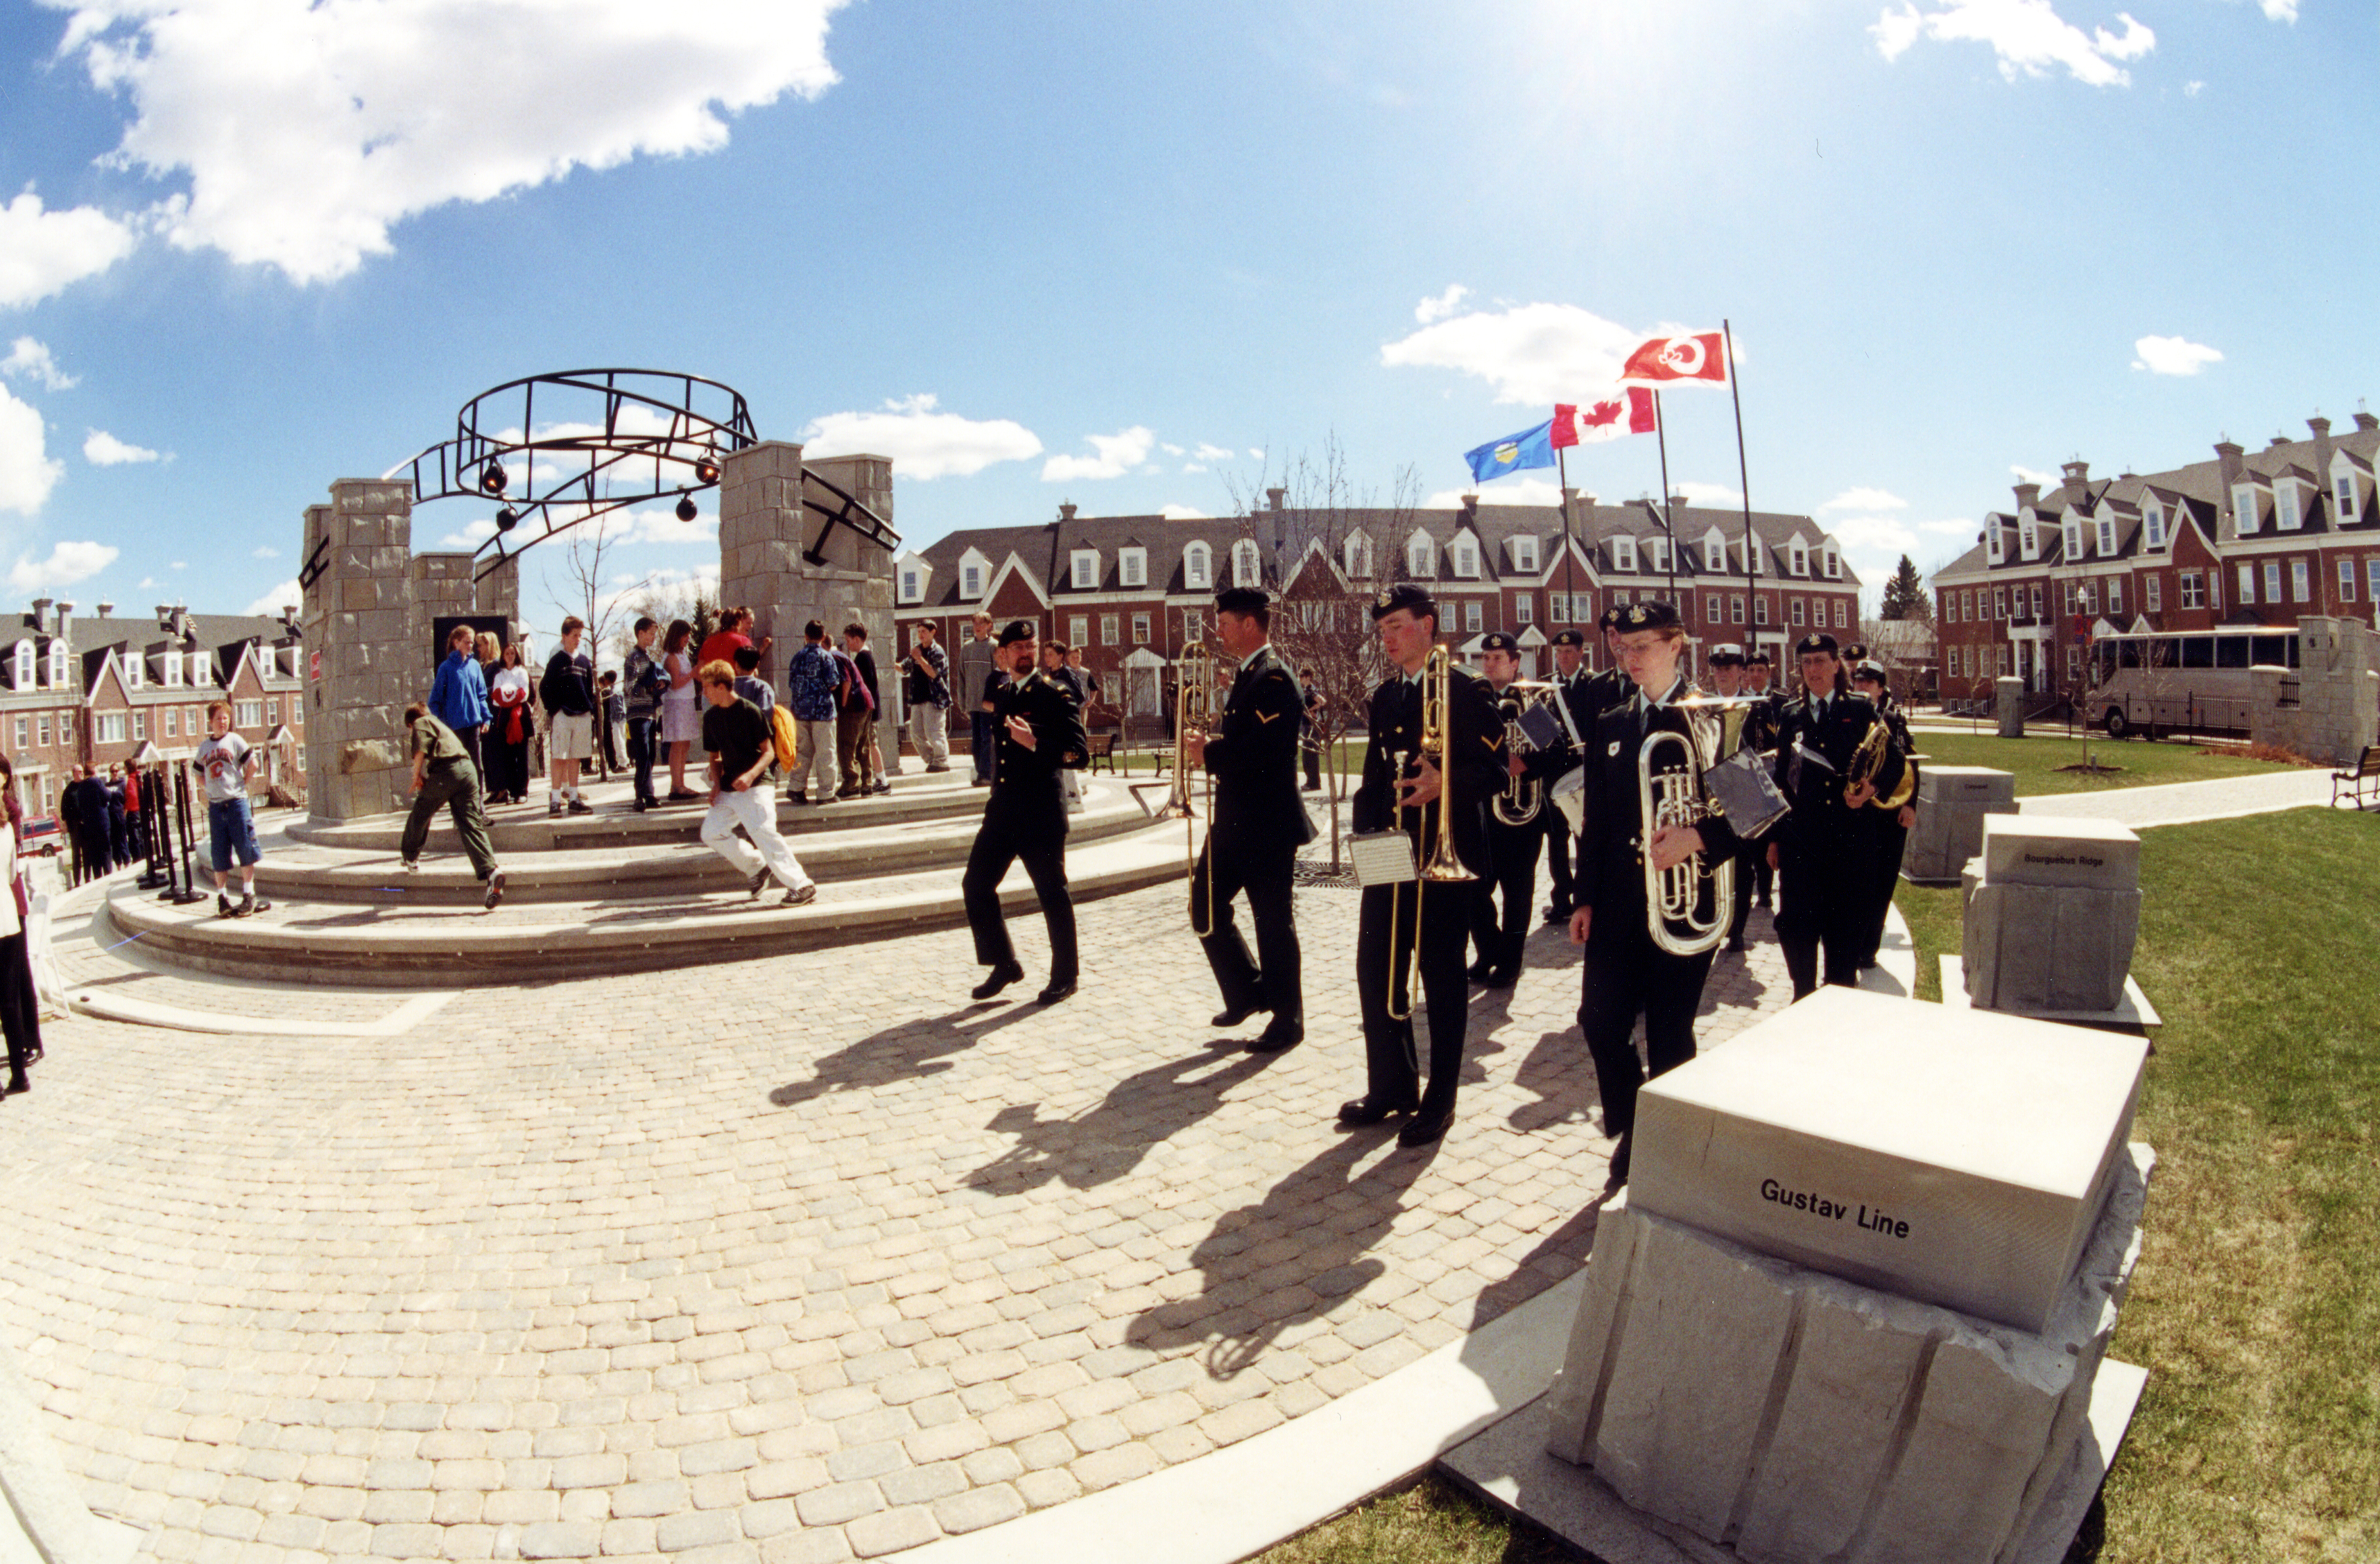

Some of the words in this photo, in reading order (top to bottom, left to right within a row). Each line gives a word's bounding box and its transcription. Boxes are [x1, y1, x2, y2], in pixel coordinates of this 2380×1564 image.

[2079, 856, 2103, 867] Ridge
[1761, 1179, 1847, 1220] Gustav
[1857, 1205, 1910, 1238] Line
